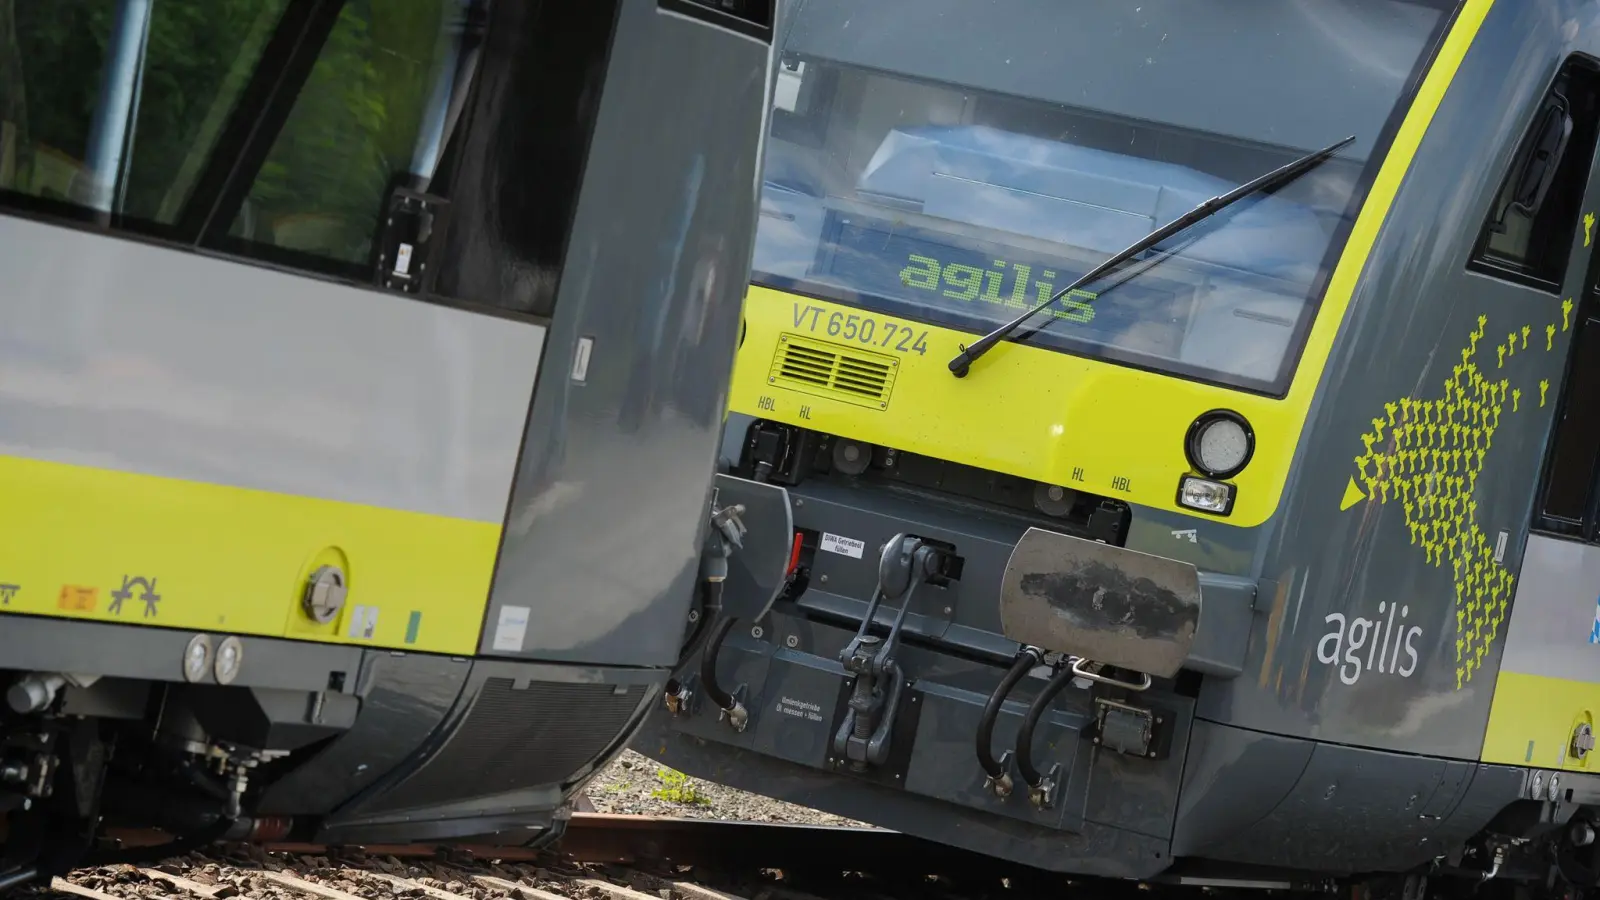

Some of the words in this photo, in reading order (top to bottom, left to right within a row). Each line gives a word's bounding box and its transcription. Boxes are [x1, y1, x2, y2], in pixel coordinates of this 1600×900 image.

[899, 254, 1098, 323] agilis
[793, 303, 825, 332] VT
[827, 311, 929, 356] 650.724
[758, 396, 776, 412] HBL
[799, 405, 811, 420] HL
[1071, 467, 1084, 482] HL
[1111, 476, 1131, 492] HBL
[1317, 601, 1423, 685] agilis
